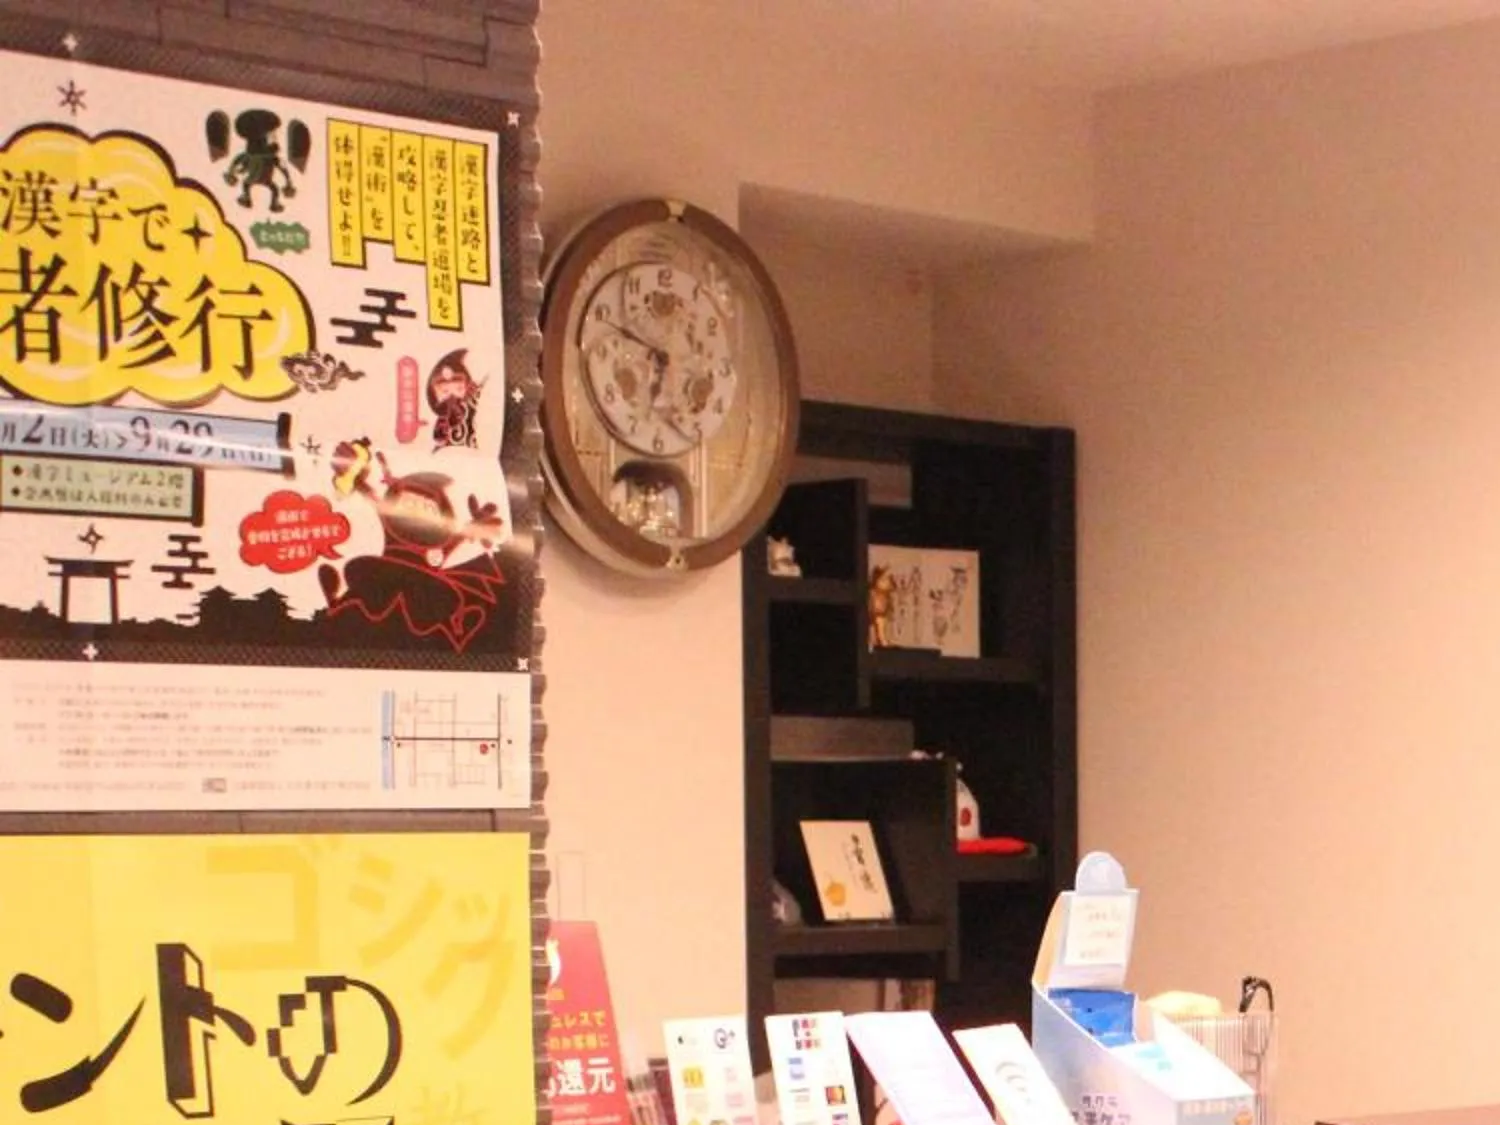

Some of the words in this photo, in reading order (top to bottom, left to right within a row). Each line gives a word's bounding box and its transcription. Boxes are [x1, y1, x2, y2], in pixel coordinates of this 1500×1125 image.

[0, 169, 170, 252] 漢字で
[0, 246, 274, 381] 者修行
